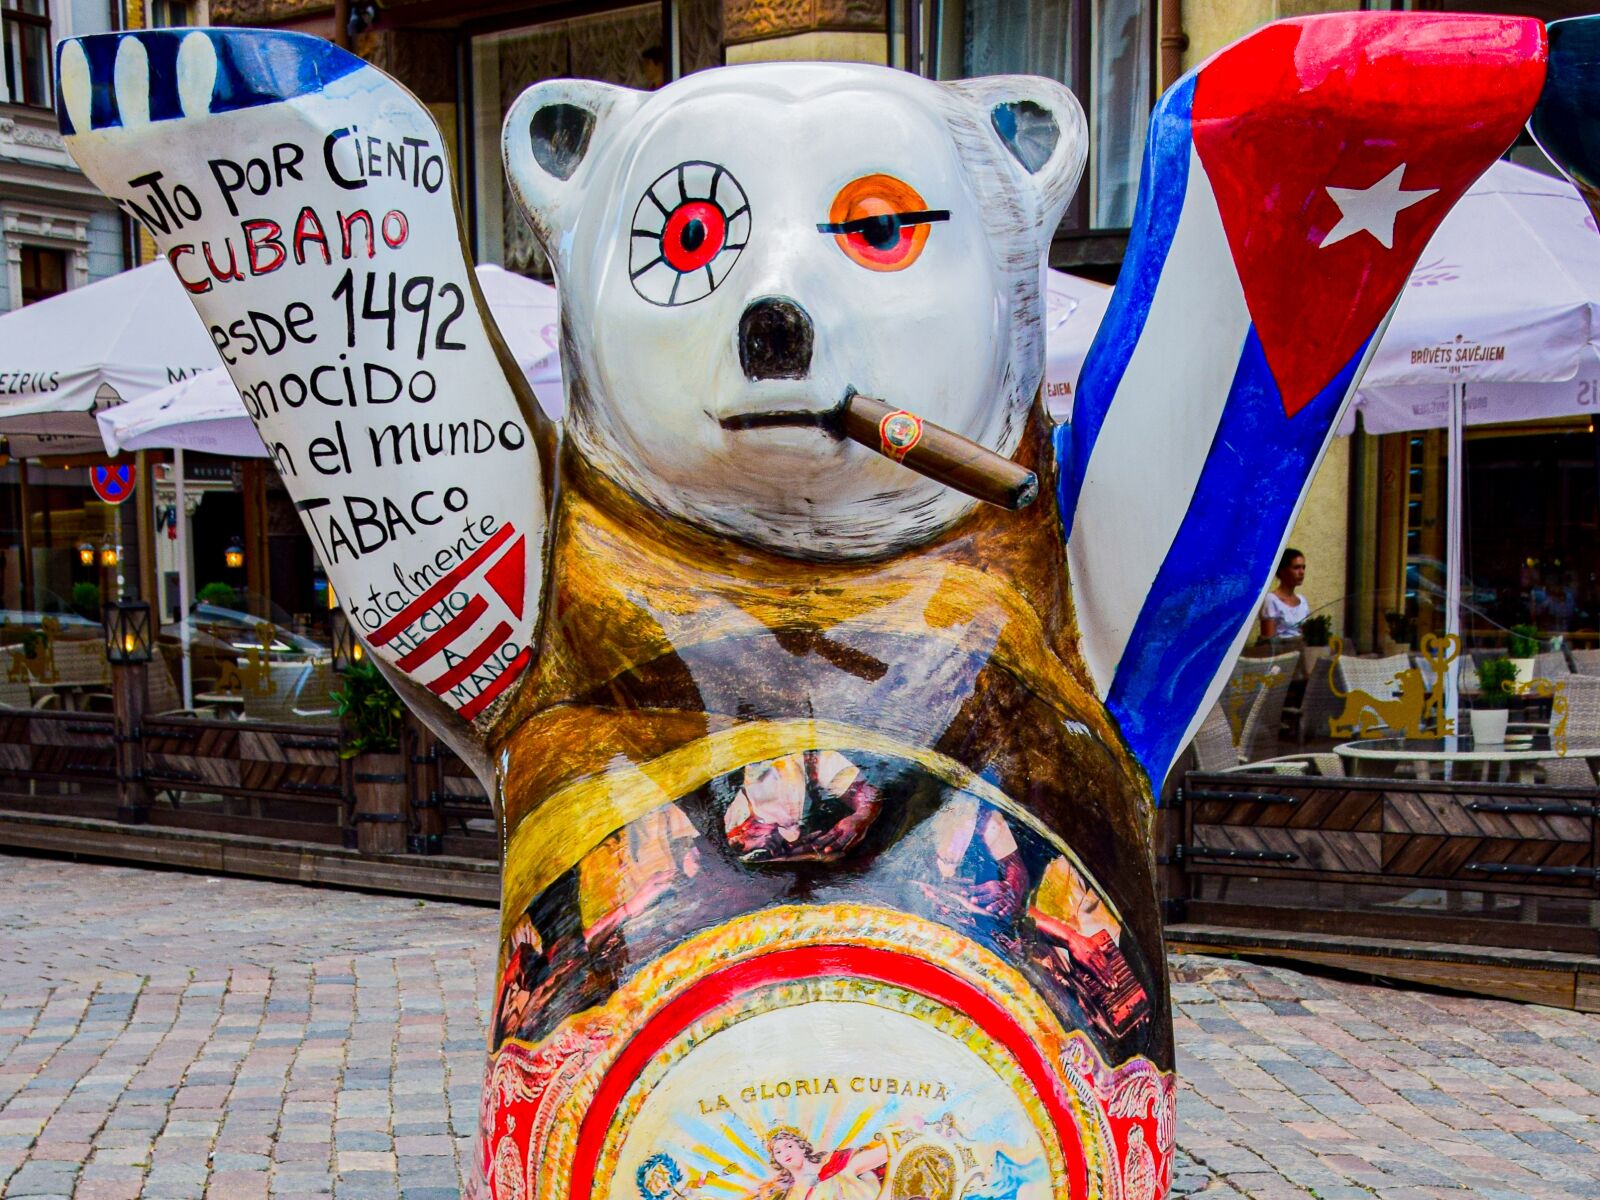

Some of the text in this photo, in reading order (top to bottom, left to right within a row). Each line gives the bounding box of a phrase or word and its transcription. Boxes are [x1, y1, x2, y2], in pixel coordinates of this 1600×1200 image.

[118, 171, 202, 236] NTO
[208, 142, 304, 217] POR
[332, 267, 467, 360] 1492
[308, 420, 352, 475] el
[349, 514, 499, 633] totalmente
[387, 591, 469, 658] HECHO
[441, 647, 467, 670] A
[449, 642, 520, 706] MANO
[697, 1076, 948, 1115] LA GLORIA CUBANA
